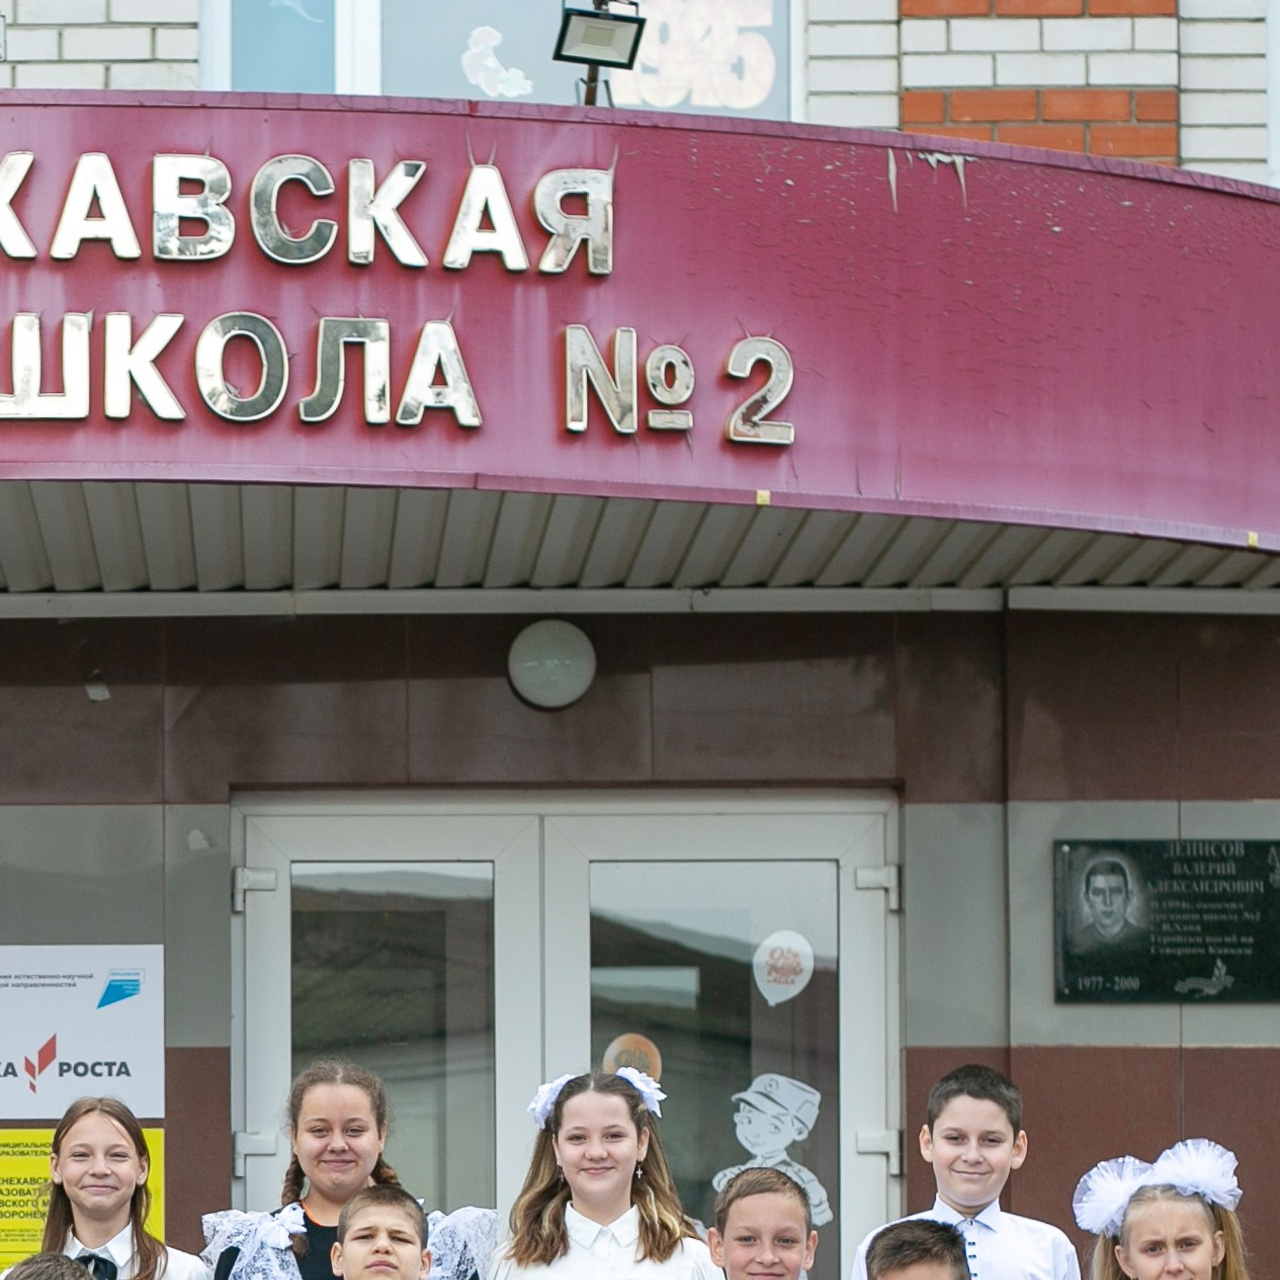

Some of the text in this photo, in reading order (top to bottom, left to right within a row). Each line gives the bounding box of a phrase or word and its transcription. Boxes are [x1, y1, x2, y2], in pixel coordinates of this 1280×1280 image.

[1163, 841, 1245, 858] ДЕНИСОВ
[1172, 859, 1237, 876] ВАЛЕРИЙ
[1146, 879, 1265, 894] АЛЕКСАНДРОВИЧ
[58, 1061, 131, 1078] РОСТА
